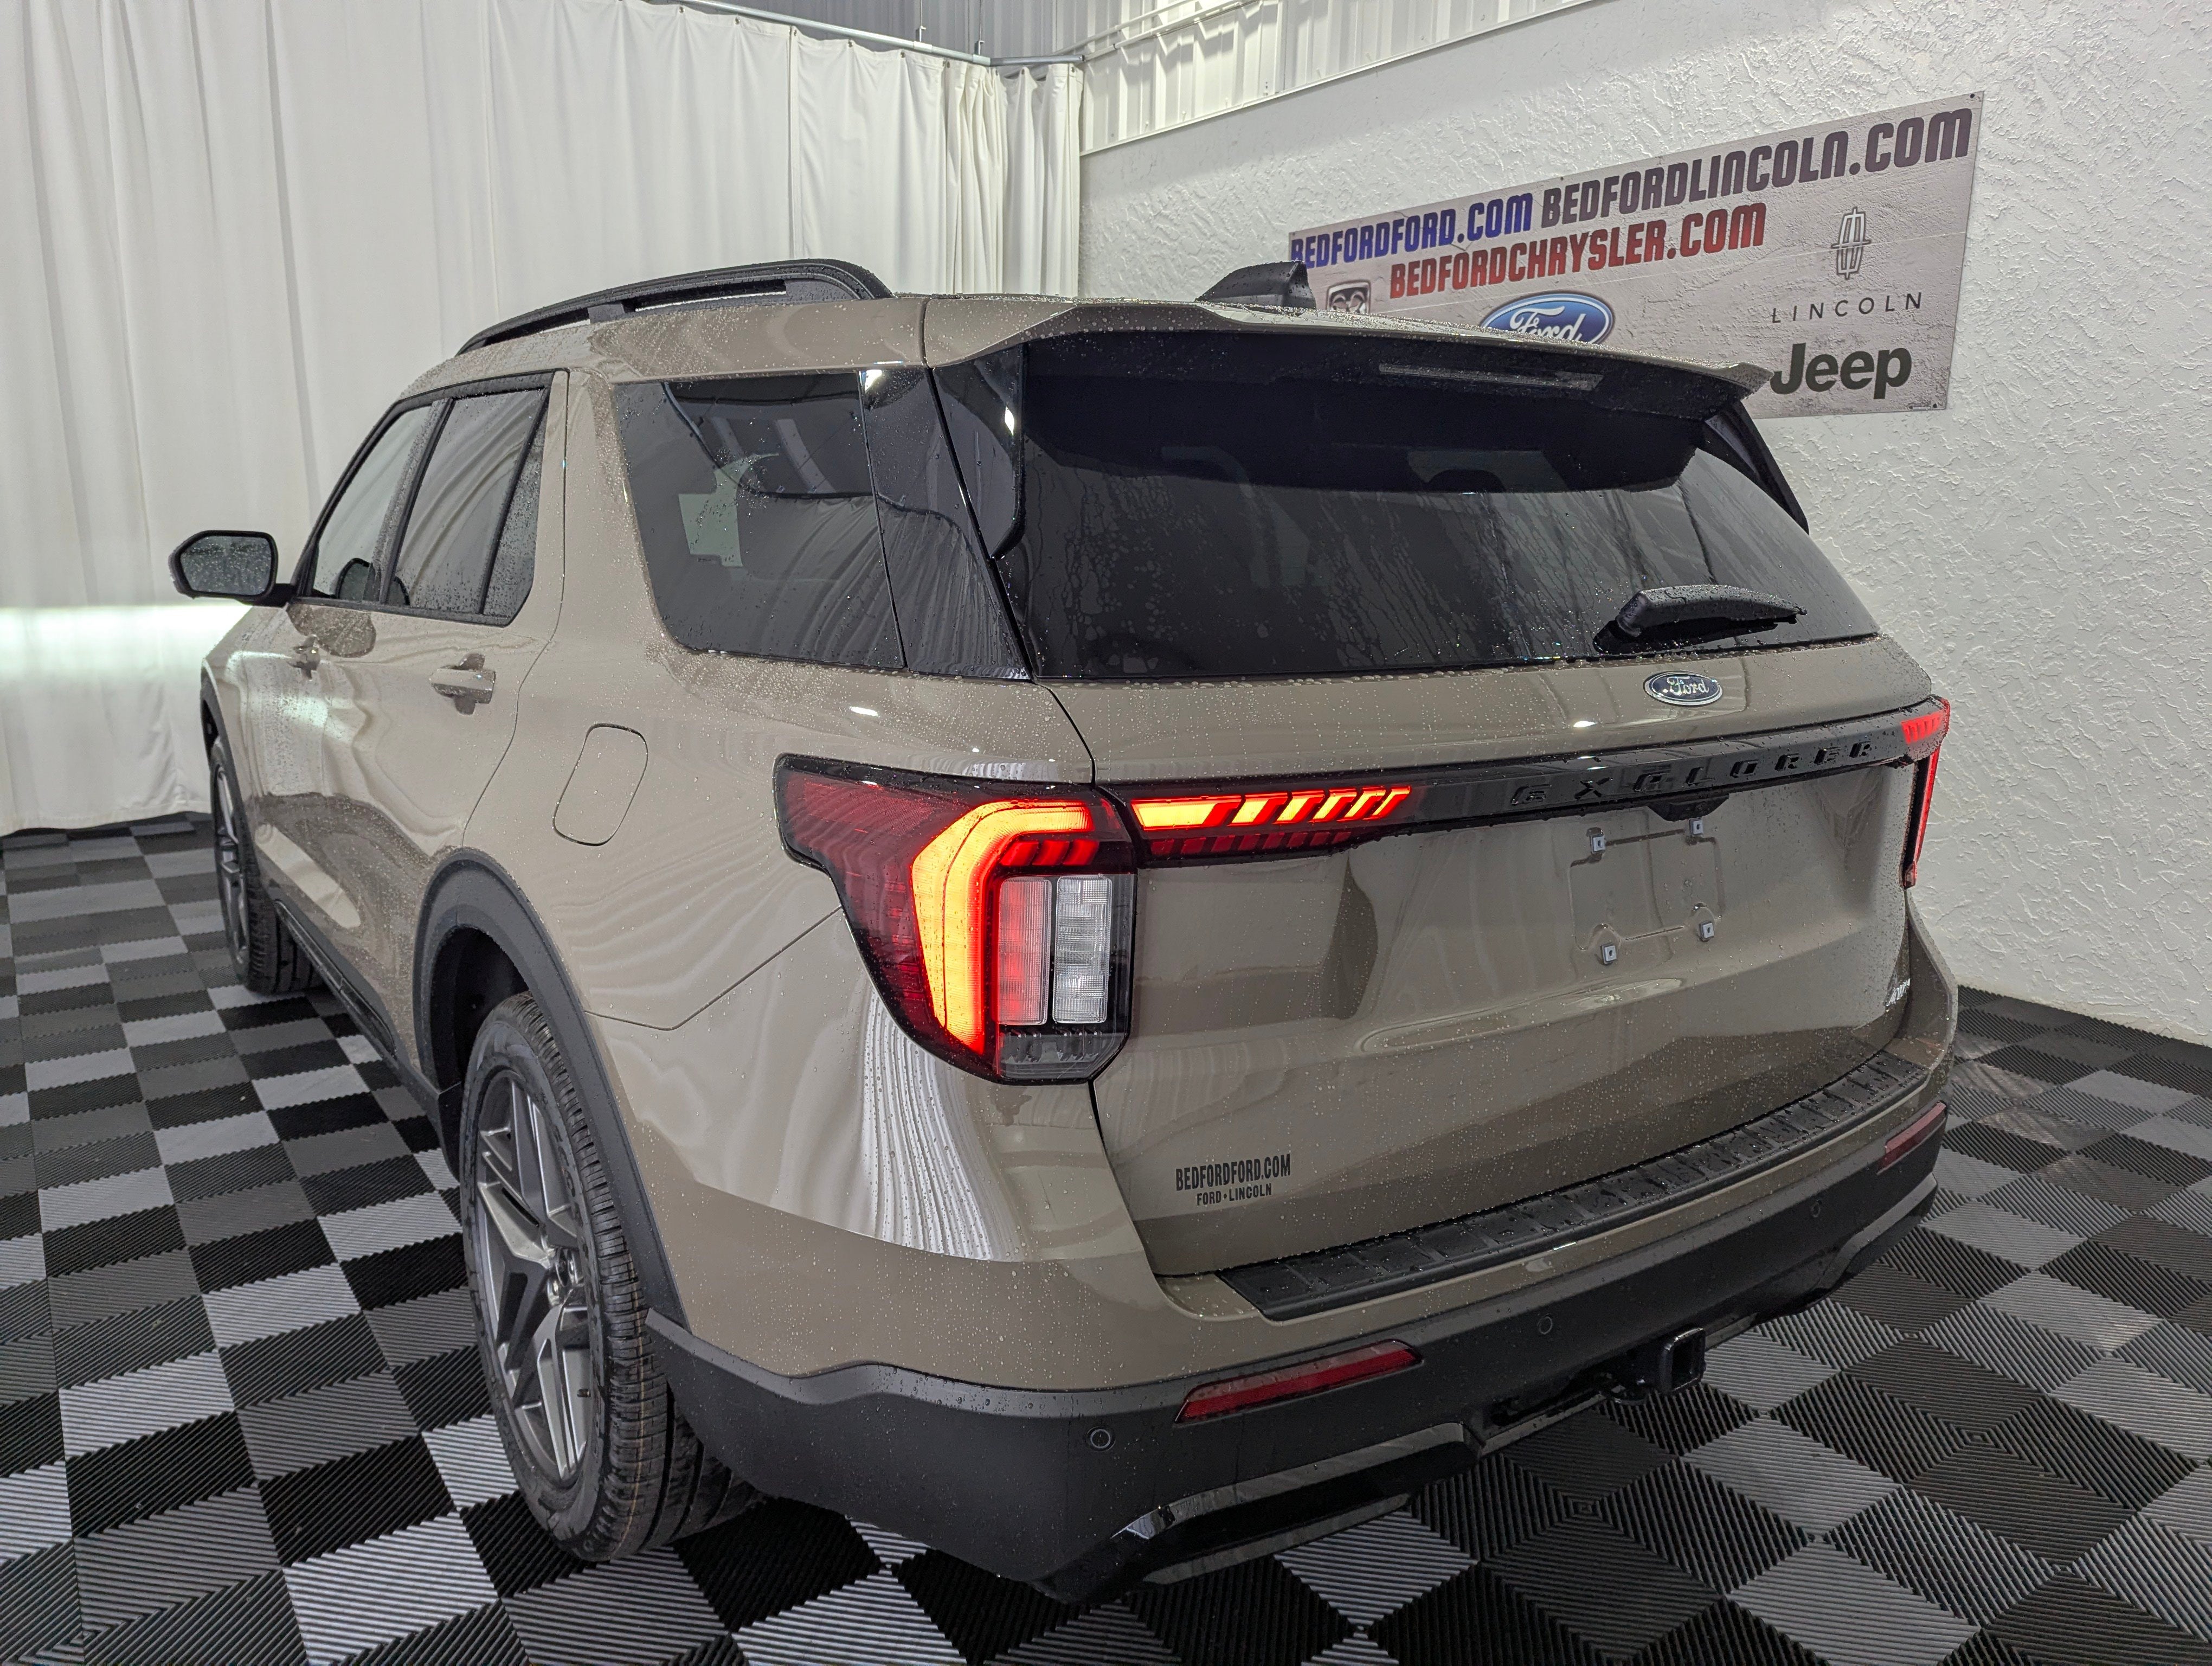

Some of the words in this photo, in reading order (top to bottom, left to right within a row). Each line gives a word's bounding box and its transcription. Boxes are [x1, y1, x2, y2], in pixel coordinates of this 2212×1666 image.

[1290, 193, 1533, 269] BEDFORDFORD.COM
[1541, 108, 1973, 229] BEDFORDLINCOLN.COM
[1390, 202, 1767, 299] BEDFORDCHRYSLER.COM
[1772, 292, 1922, 324] LINCOLN
[1770, 342, 1912, 400] Jeep
[1666, 675, 1709, 696] Ford
[1175, 1154, 1291, 1191] BEDFORDFORD.COM
